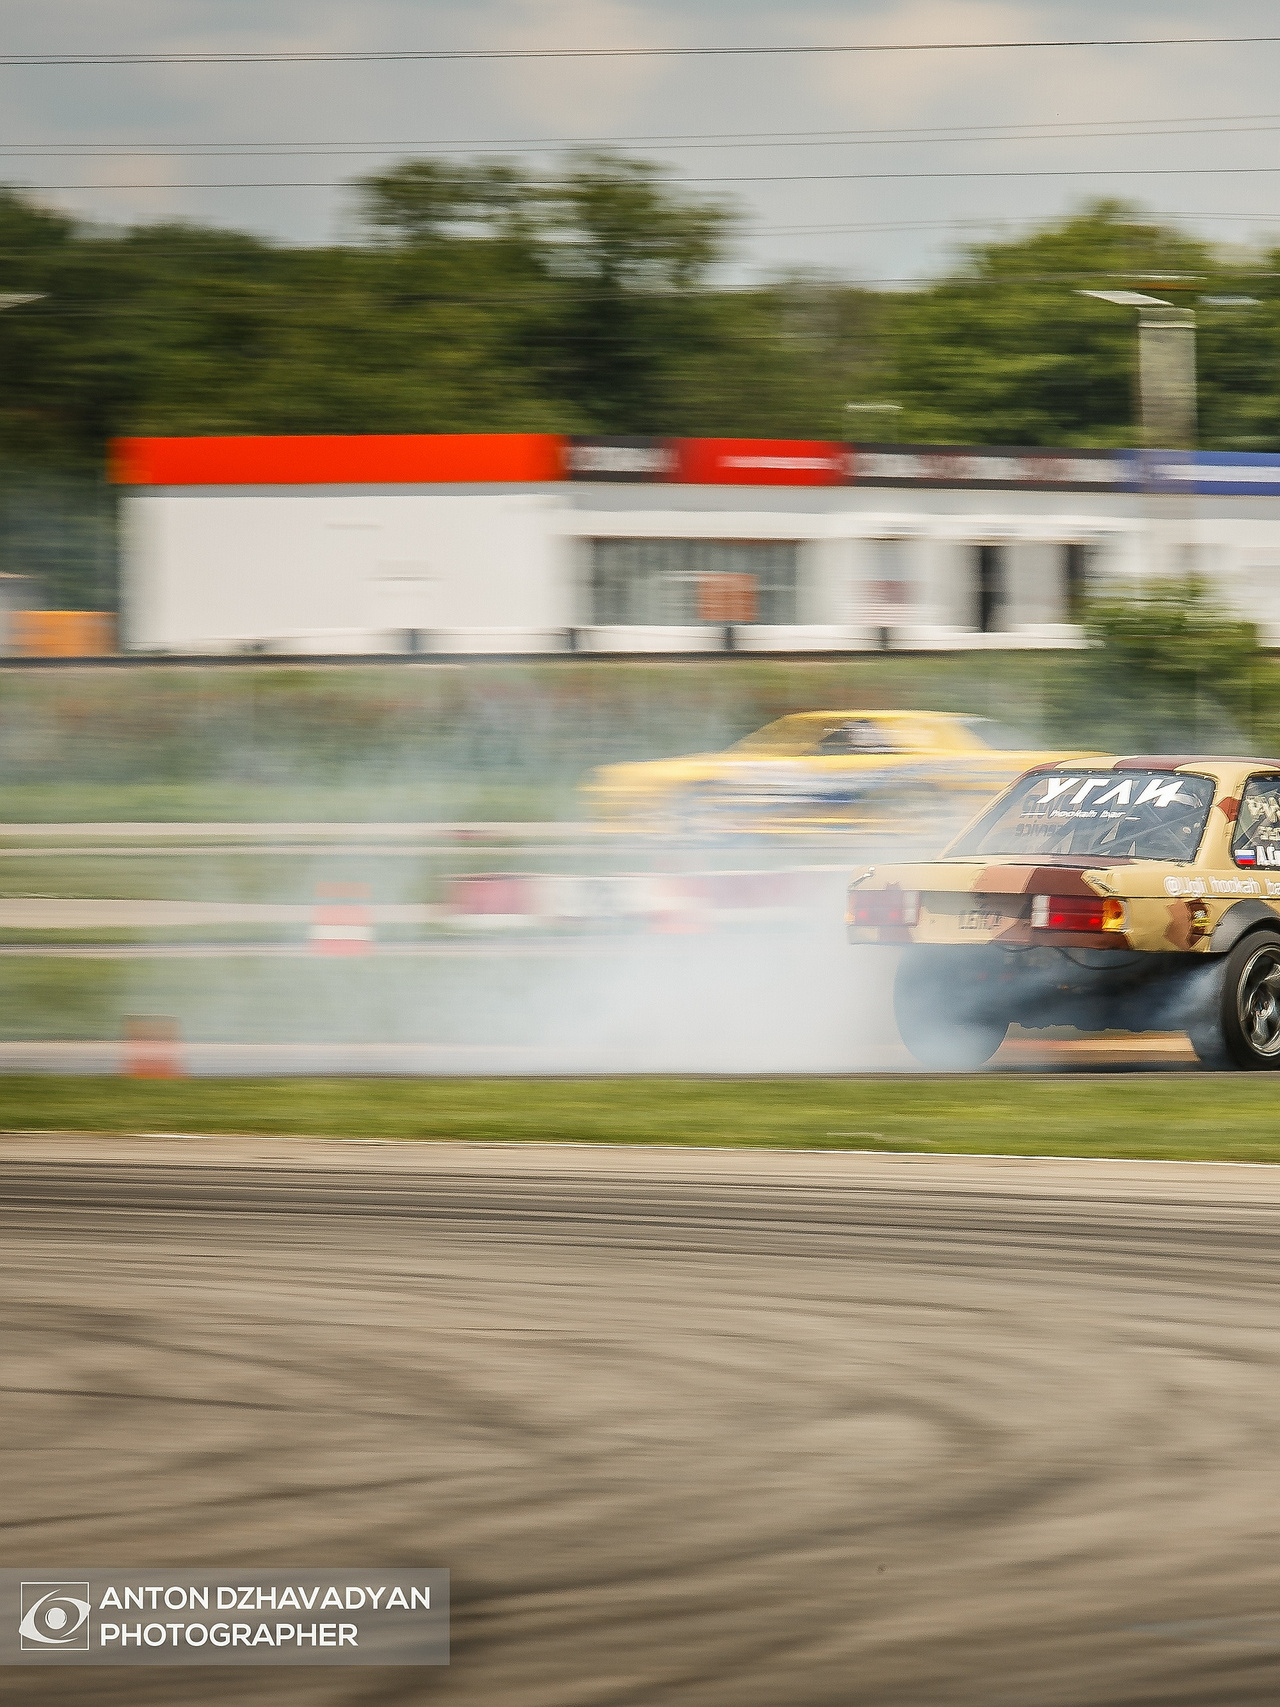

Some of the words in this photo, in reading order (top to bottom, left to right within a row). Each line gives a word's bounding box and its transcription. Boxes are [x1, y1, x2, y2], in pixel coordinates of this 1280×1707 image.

[1050, 809, 1097, 820] hookah
[1100, 810, 1126, 820] bar
[1208, 876, 1262, 895] hookah
